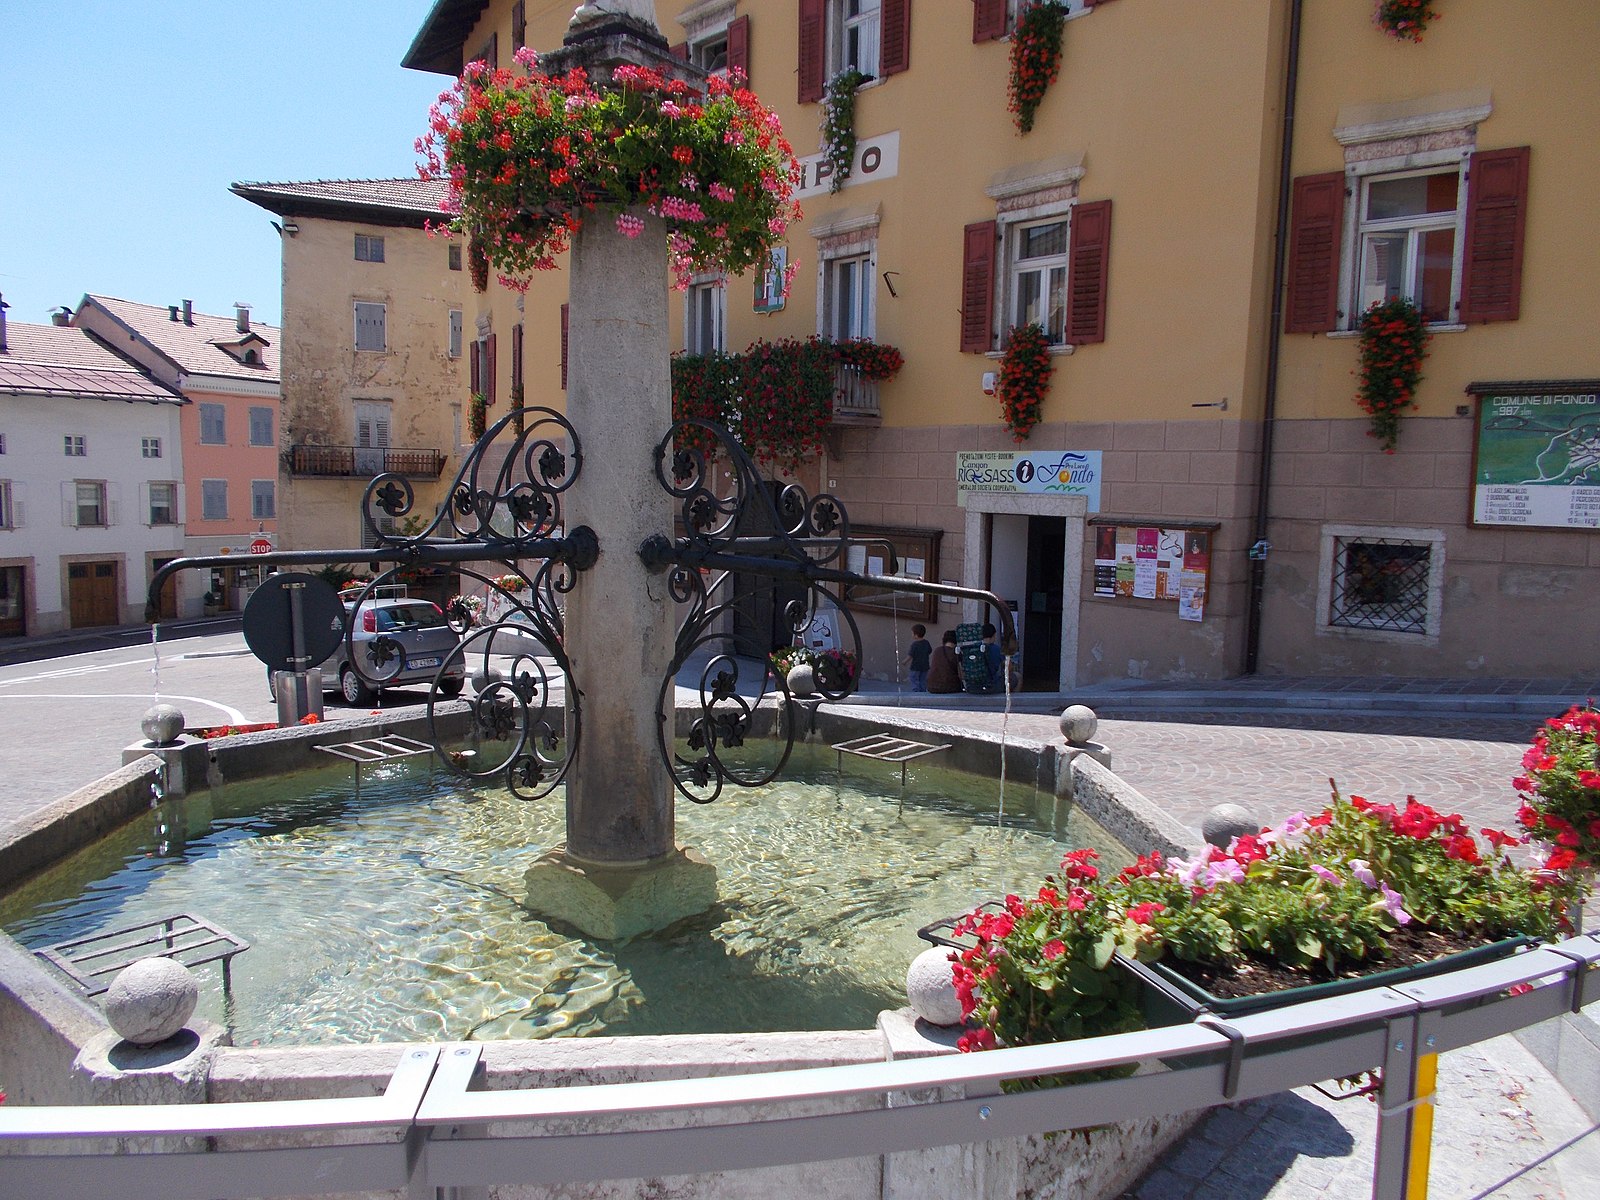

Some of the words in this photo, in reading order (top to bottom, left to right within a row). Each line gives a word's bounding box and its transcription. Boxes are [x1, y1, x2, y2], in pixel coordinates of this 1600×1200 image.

[1493, 395, 1541, 406] COMUNE
[1543, 395, 1552, 405] DI
[1554, 394, 1596, 405] FONDO
[1499, 406, 1519, 416] 987
[962, 459, 988, 471] Canyon
[982, 468, 1015, 483] SASS
[251, 545, 271, 553] STOP
